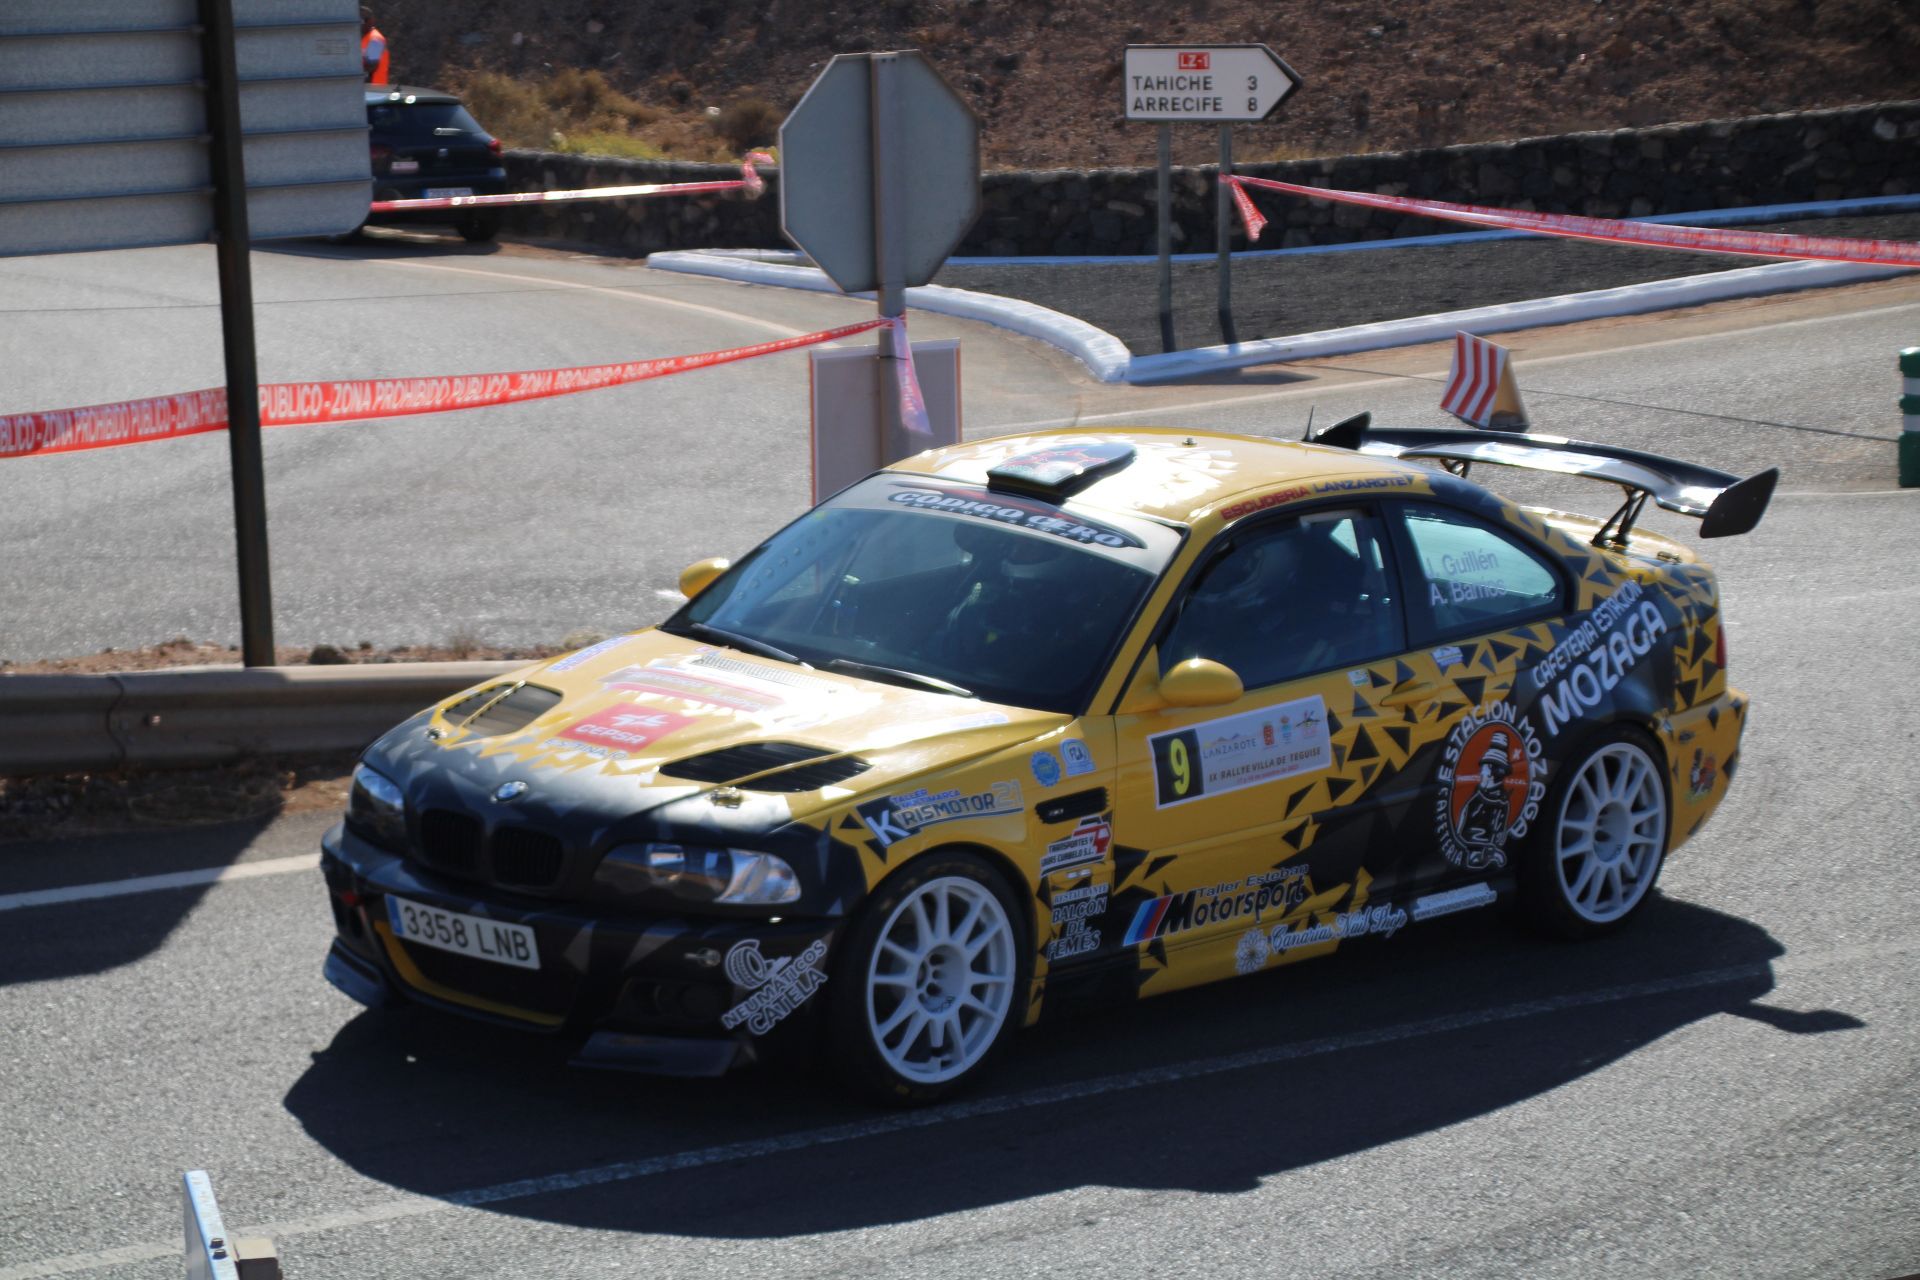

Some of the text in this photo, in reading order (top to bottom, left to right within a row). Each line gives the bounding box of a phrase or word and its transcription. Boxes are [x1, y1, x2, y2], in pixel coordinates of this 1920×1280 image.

[1180, 54, 1208, 68] LZ-1
[1132, 75, 1258, 91] TAHICHE 3
[1133, 97, 1258, 112] ARRECIFE 8
[258, 384, 321, 418] PUBLICO
[332, 382, 371, 415] ZONA
[374, 378, 451, 411] PROHIBIDO
[1221, 476, 1409, 520] ESCUDERIA LANZAROTE
[891, 491, 1126, 546] CODIGO CERO
[1442, 549, 1500, 576] Guillén
[1431, 582, 1448, 606] A.
[1532, 620, 1598, 689] CAFETERIA
[575, 724, 646, 744] CEPSA
[1202, 737, 1257, 760] LANZAROTE
[1437, 700, 1517, 782] ESTACION
[1170, 737, 1190, 796] 9
[1251, 759, 1275, 772] VILLA
[1276, 755, 1286, 766] DE
[1198, 863, 1309, 898] Taller Esteban
[1156, 873, 1306, 936] Motorsport
[404, 906, 531, 961] 3358 LNB
[1067, 918, 1087, 937] DE
[722, 940, 826, 1028] NEUMATICOS
